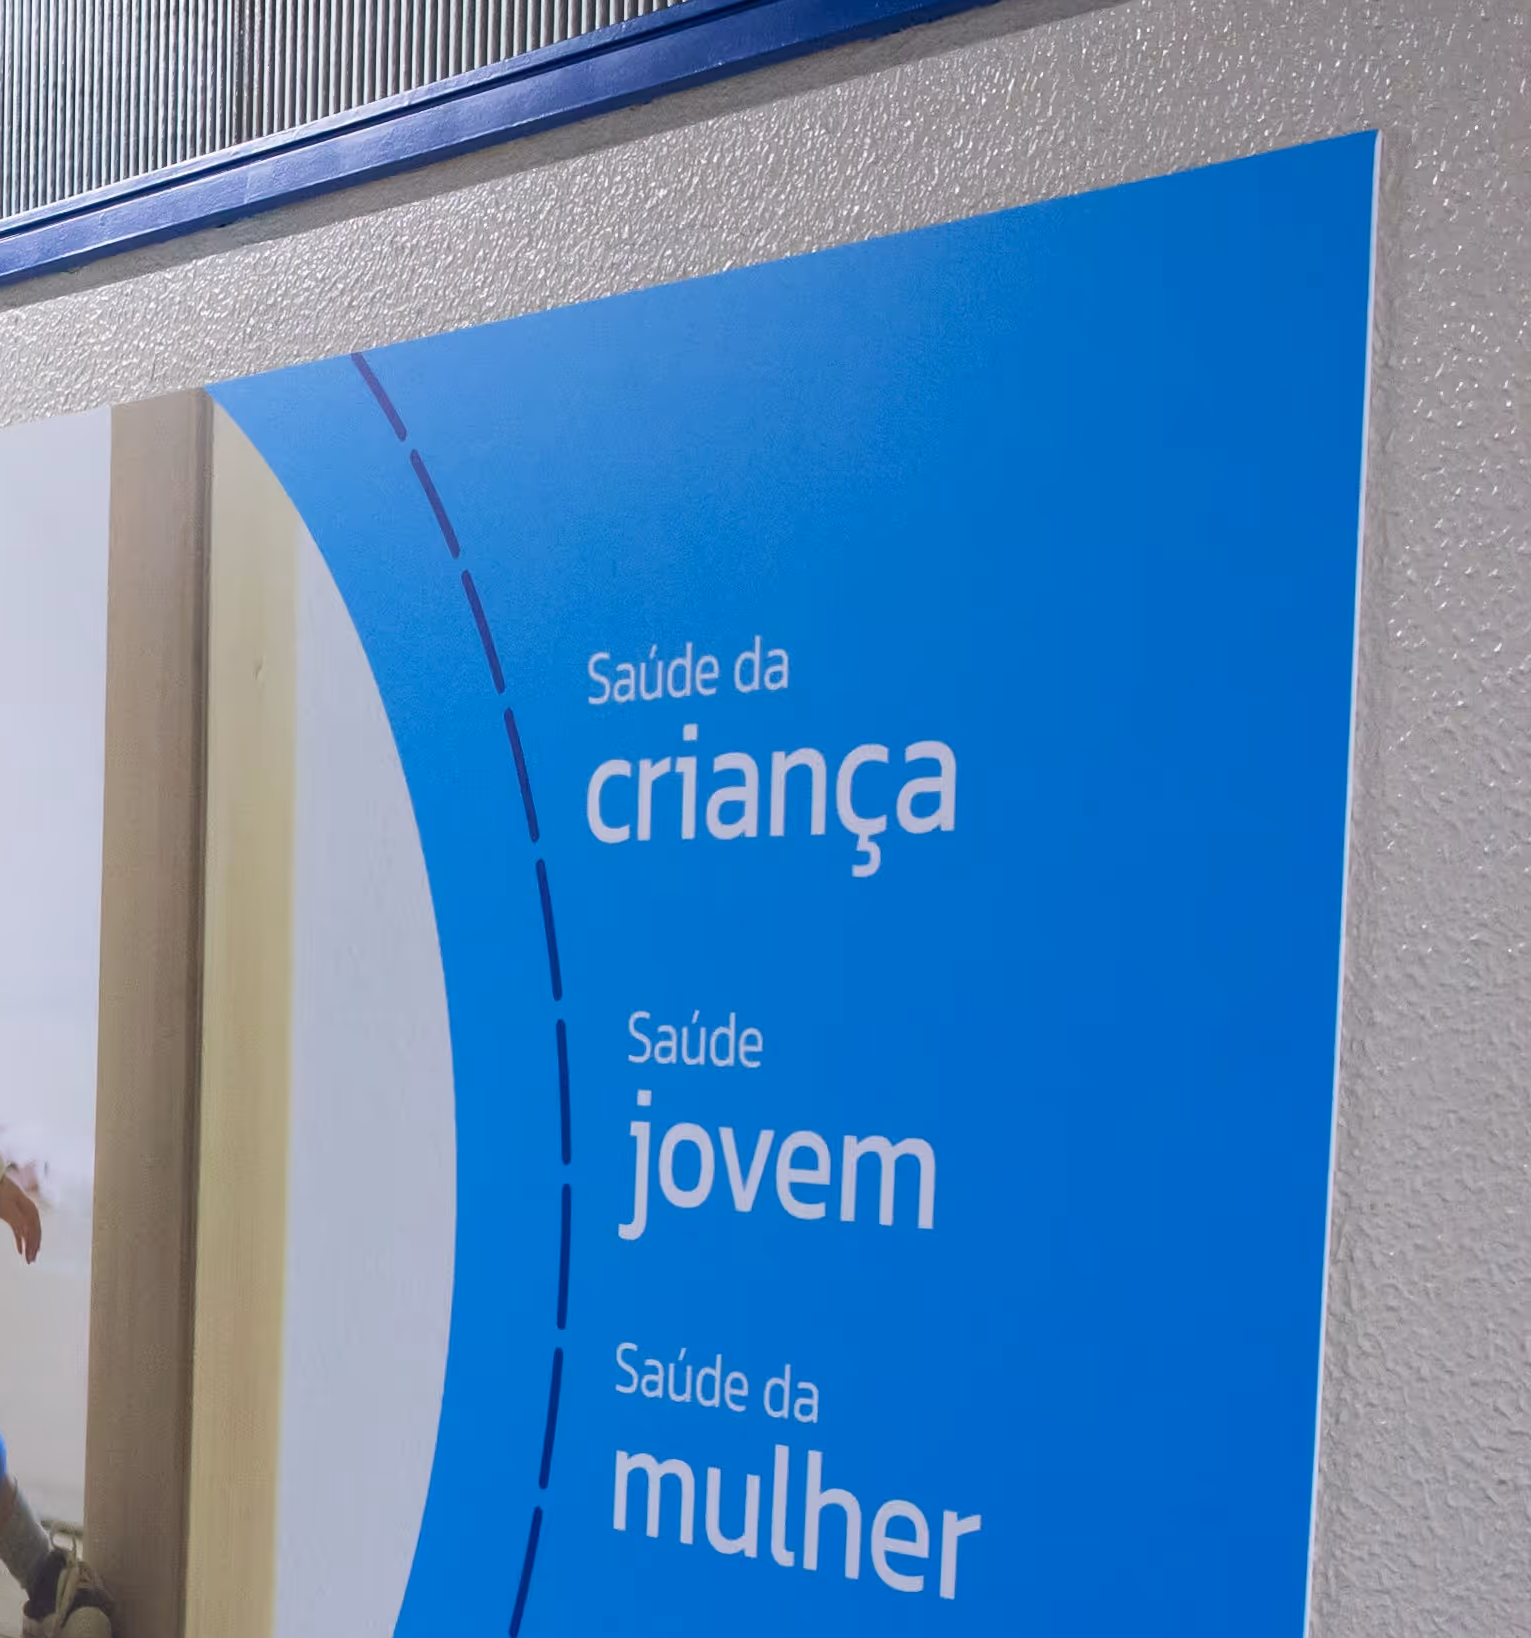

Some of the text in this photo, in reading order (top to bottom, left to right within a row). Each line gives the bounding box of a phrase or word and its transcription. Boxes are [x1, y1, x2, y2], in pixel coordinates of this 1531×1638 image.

[587, 635, 790, 705] Saúde da
[586, 723, 957, 878] criança
[627, 1009, 764, 1069] Saúde
[618, 1089, 937, 1241] jovem
[615, 1342, 820, 1424] Saúde da
[612, 1444, 981, 1600] mulher
